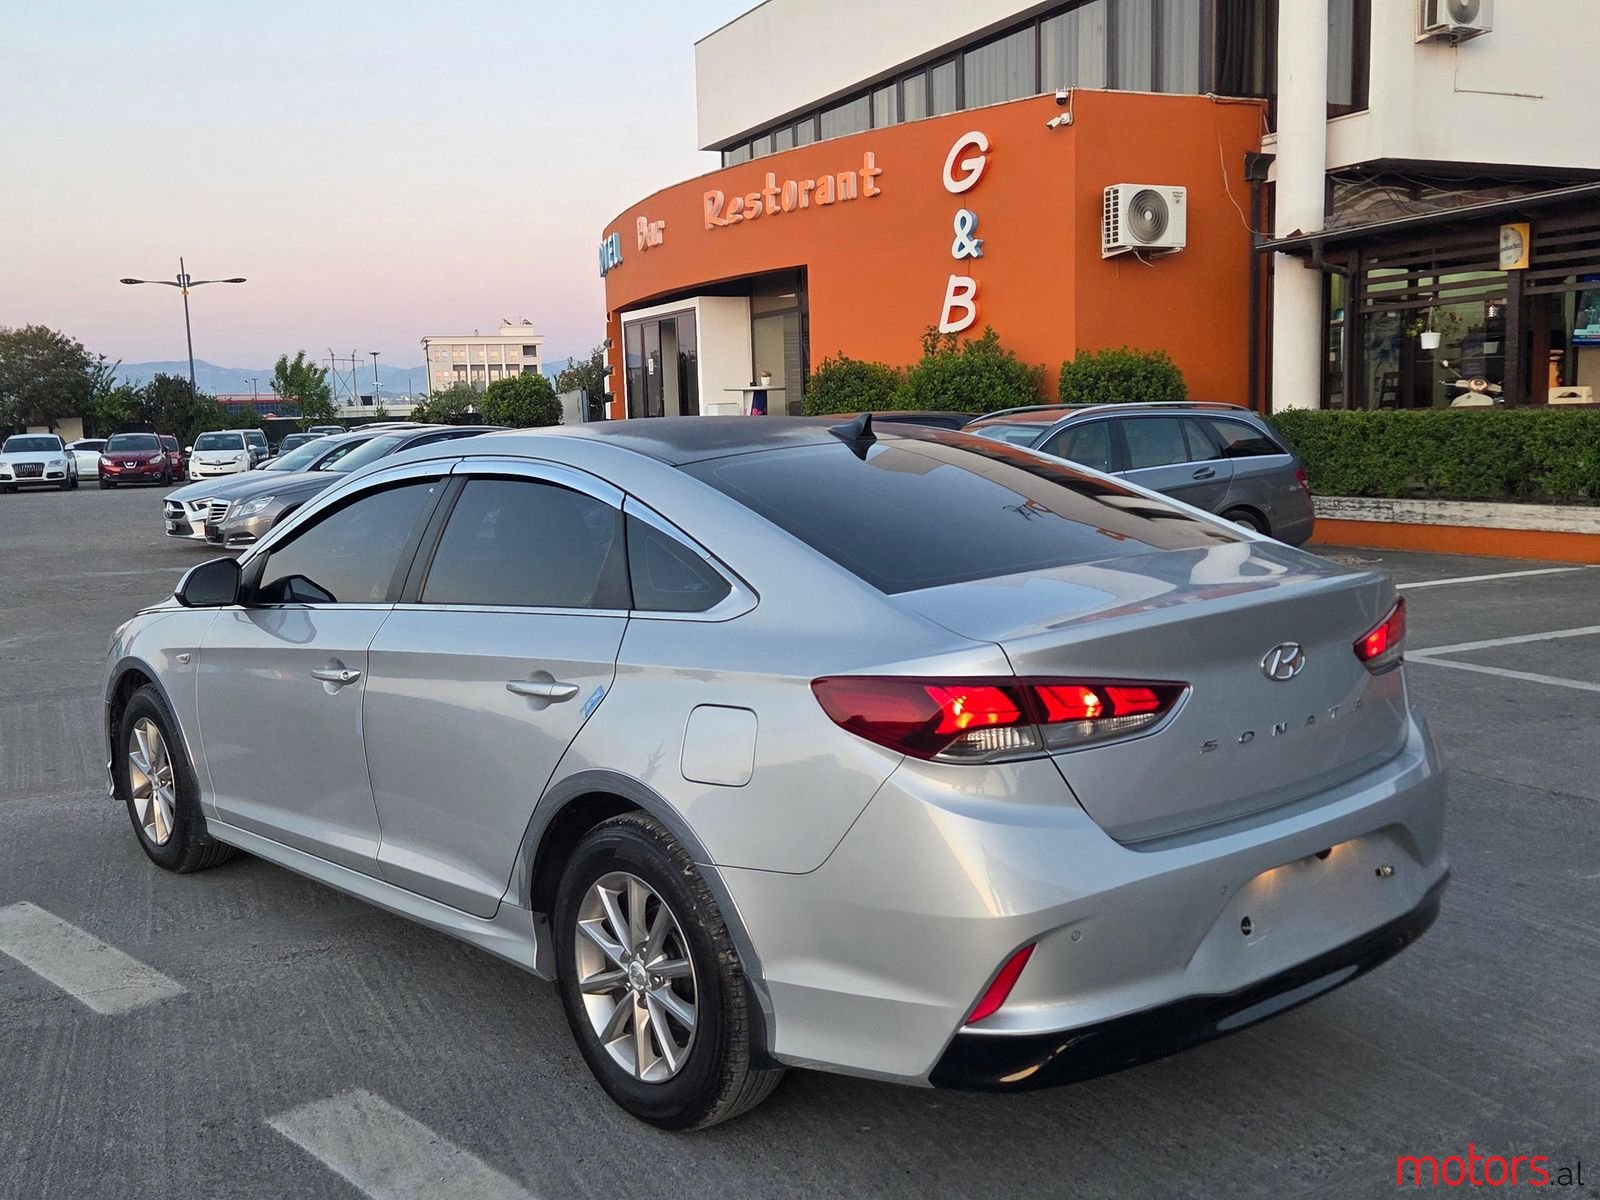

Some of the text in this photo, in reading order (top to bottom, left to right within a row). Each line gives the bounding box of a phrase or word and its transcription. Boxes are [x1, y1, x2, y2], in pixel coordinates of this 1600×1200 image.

[636, 215, 666, 252] Bar
[703, 151, 882, 231] Restorant
[938, 131, 994, 335] G & B
[1199, 697, 1363, 754] SONATA
